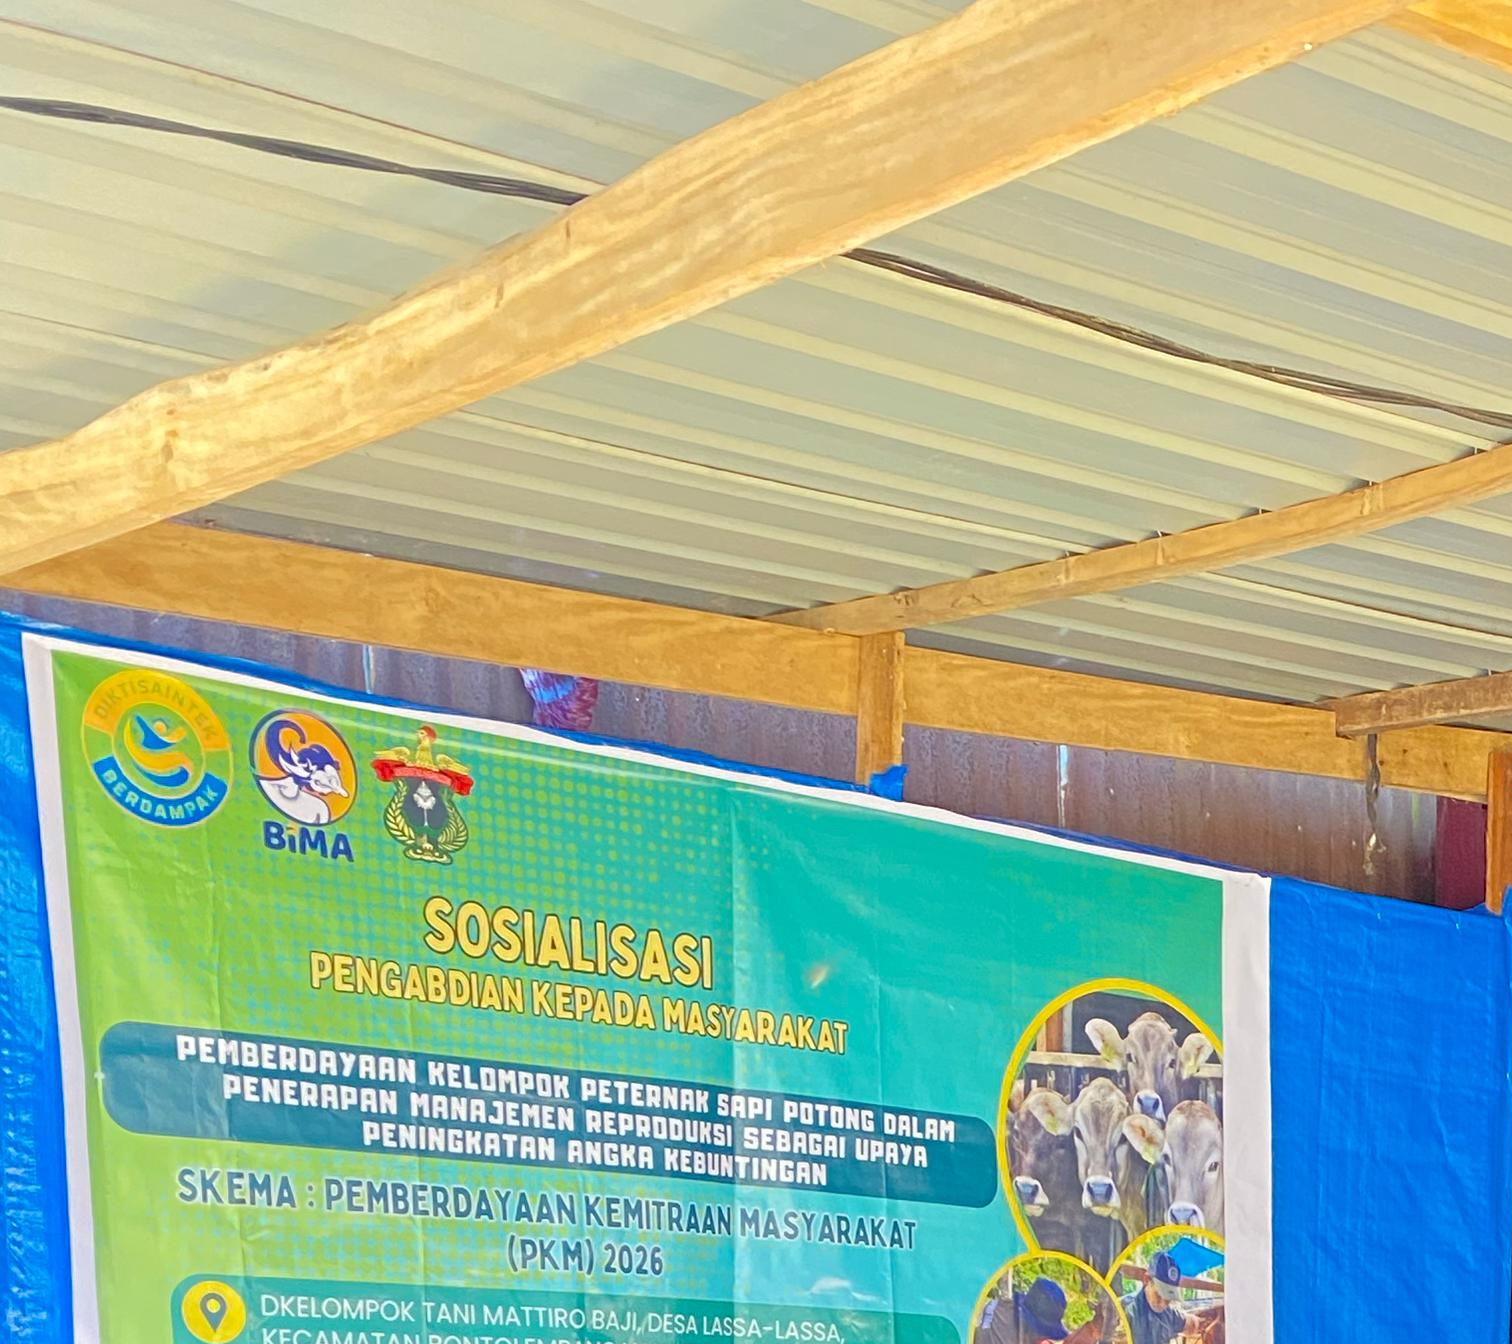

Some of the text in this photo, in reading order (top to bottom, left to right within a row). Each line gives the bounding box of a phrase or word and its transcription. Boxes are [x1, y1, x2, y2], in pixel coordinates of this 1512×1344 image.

[101, 764, 219, 820] BERDAMPAK
[423, 896, 712, 989] SOSIALISASI
[310, 951, 848, 1055] PENGABDIAN KEPADA MASYARAKAT
[176, 1034, 955, 1143] PEMBERDAYAAN KELOMPOK PETERNAK SAPI POTONG DALAM
[223, 1074, 928, 1168] PENERAPAN MANAJEMEN REPRODUKSI SEBAGAI UPAYA
[363, 1121, 827, 1186] PENINGKATAN ANGKA KEBUNTINGAN
[177, 1168, 297, 1208] SKEMA
[324, 1178, 576, 1225] PEMBERDAYAAN
[586, 1195, 731, 1236] KEMITRAAN
[740, 1208, 916, 1250] MASYARAKAT
[508, 1234, 664, 1275] (PKM) 2026
[261, 1295, 415, 1322] DKELOMPOK
[423, 1302, 476, 1323] TANI
[484, 1305, 586, 1330] MATTIRO
[648, 1313, 698, 1335] DESA
